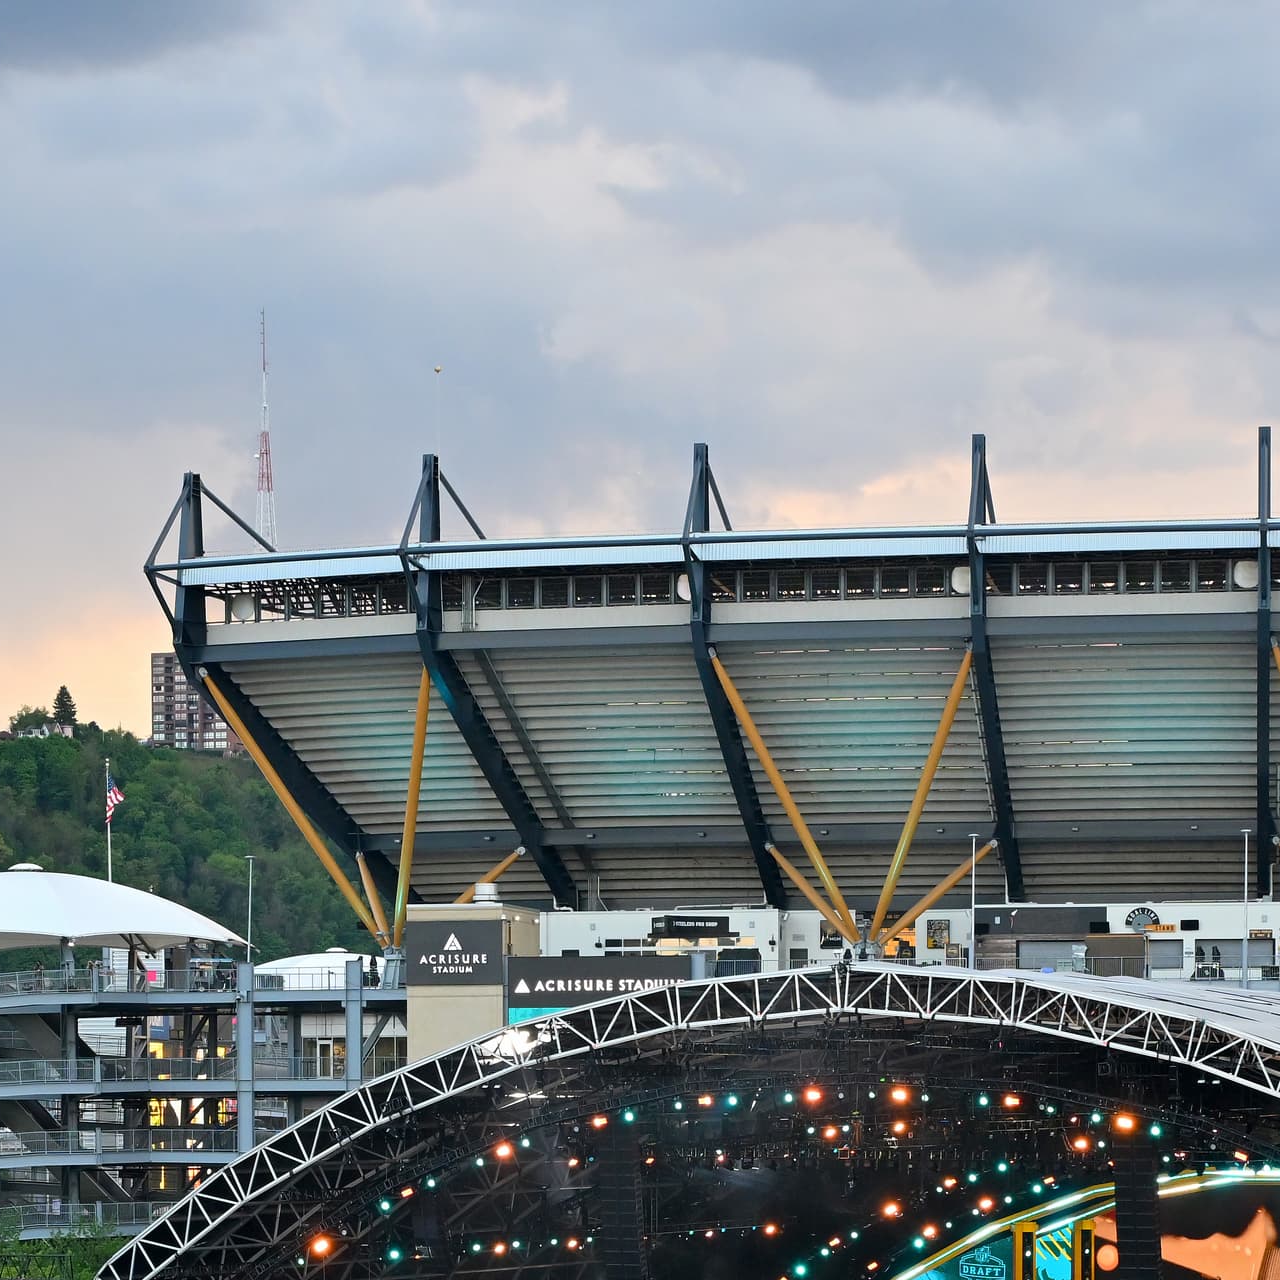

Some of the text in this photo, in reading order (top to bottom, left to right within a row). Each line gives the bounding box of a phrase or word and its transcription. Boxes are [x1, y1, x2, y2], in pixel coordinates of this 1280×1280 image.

[420, 954, 488, 965] ACRISURE
[535, 979, 613, 992] ACRISURE
[962, 1265, 1002, 1276] DRAFT
